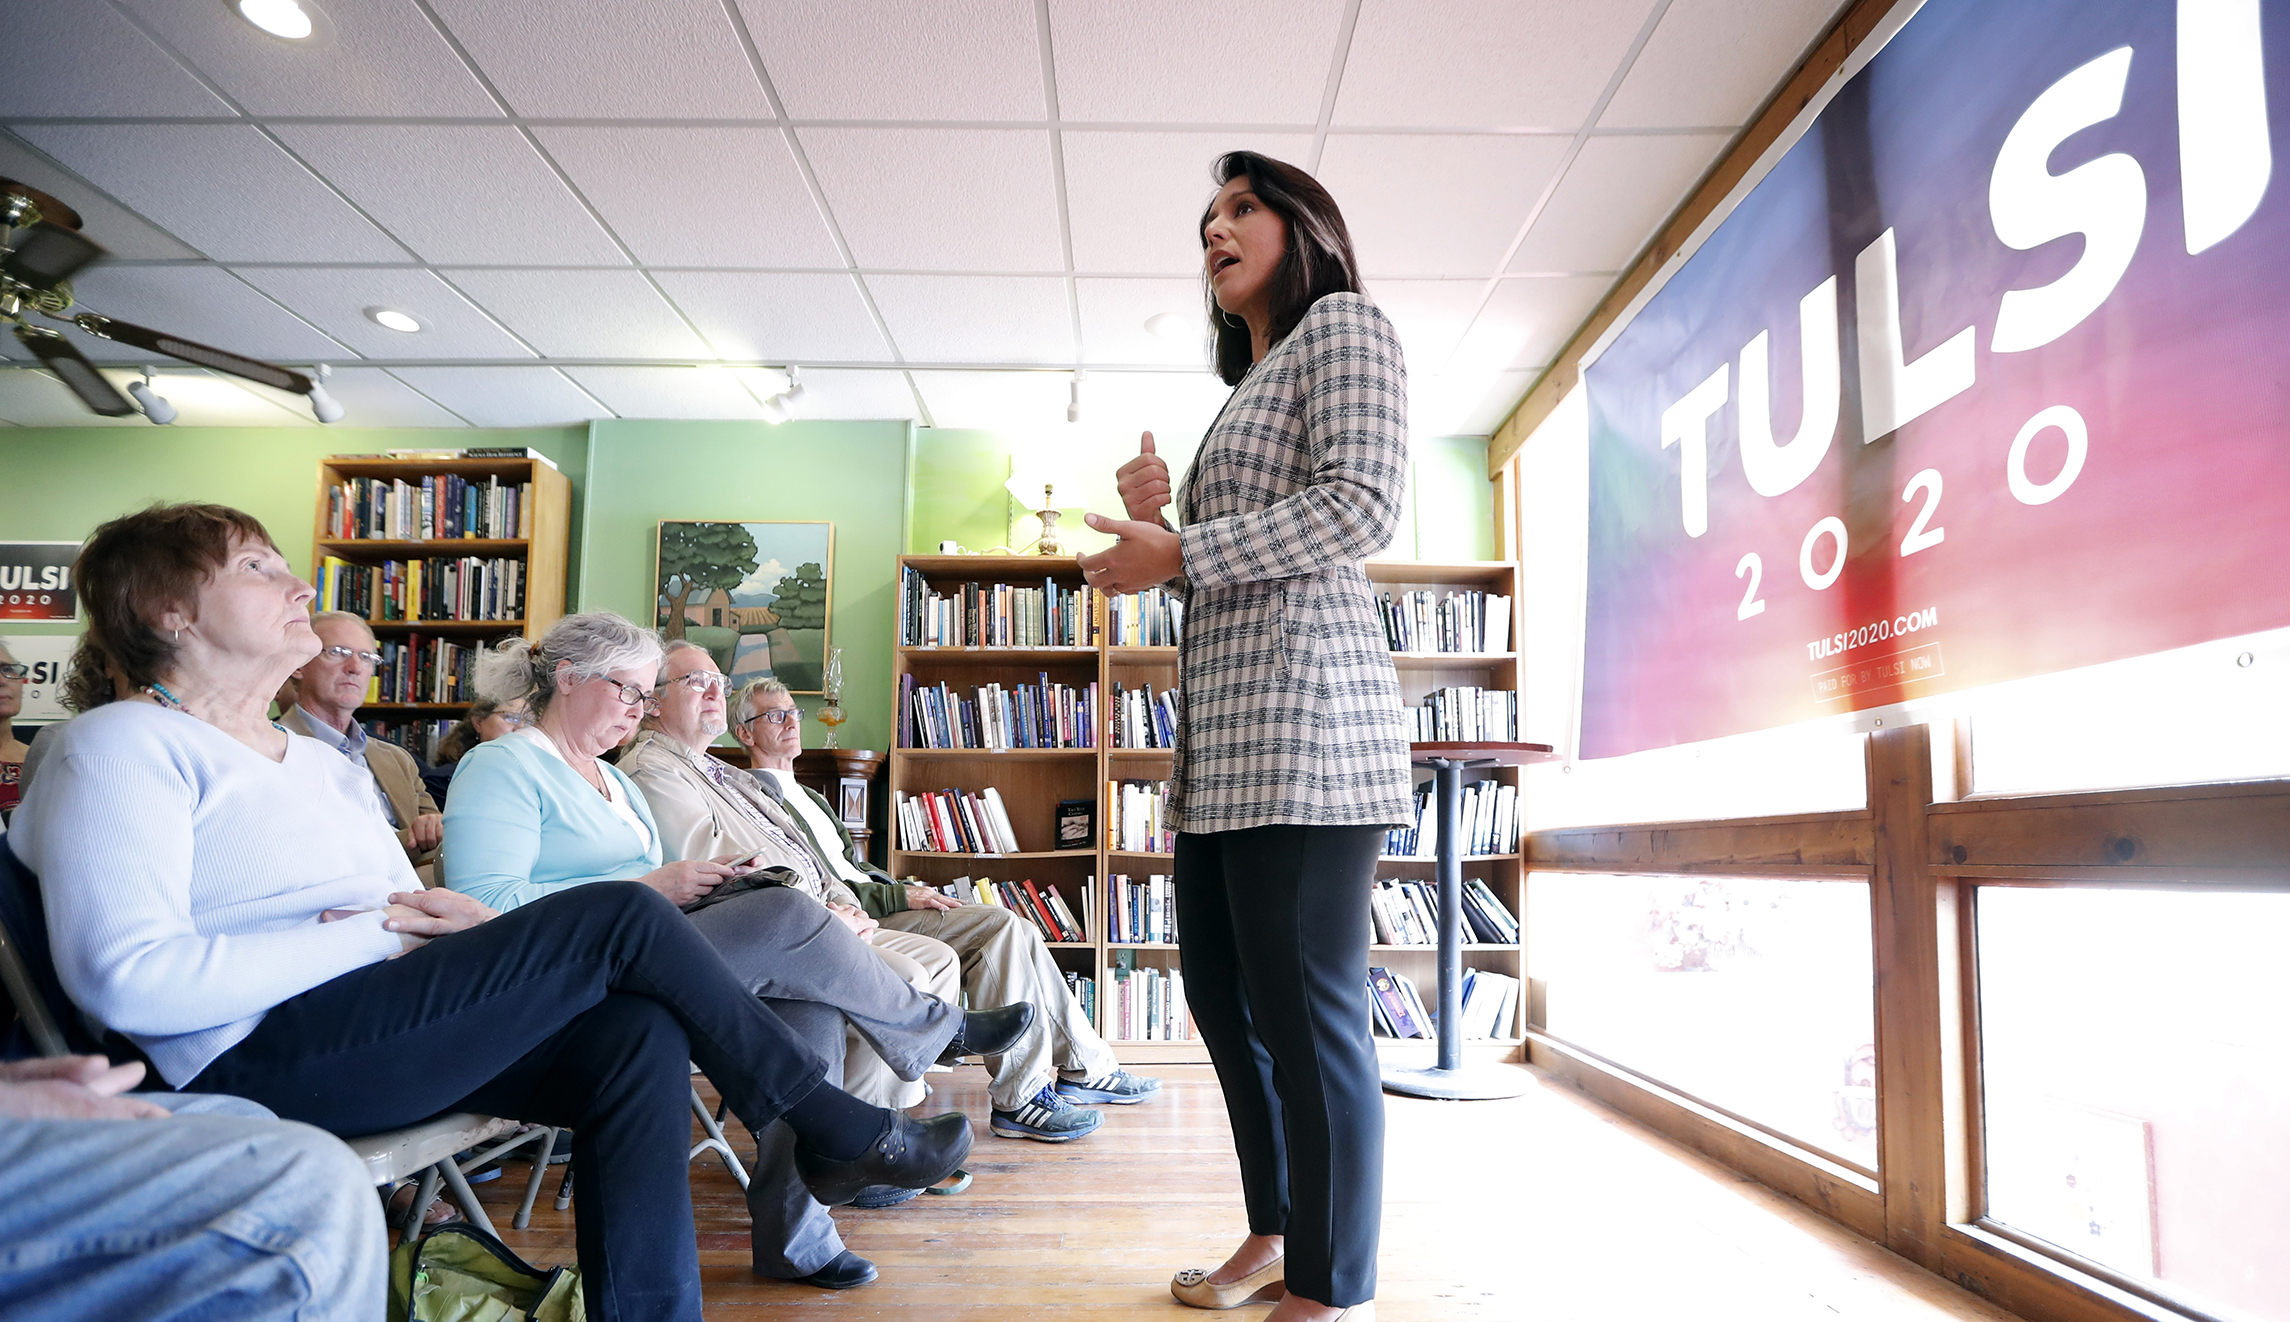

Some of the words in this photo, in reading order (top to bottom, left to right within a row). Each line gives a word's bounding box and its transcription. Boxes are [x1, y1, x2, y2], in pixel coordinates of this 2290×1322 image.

[1661, 0, 2272, 538] TULSI
[1735, 405, 2088, 620] 2020
[1807, 606, 1938, 661] TULSI2020.COM
[1818, 678, 1838, 693] PAID
[1841, 673, 1857, 687] FOR
[1860, 669, 1872, 683] BY
[1876, 661, 1906, 679] TULSI
[1910, 654, 1932, 671] NOW
